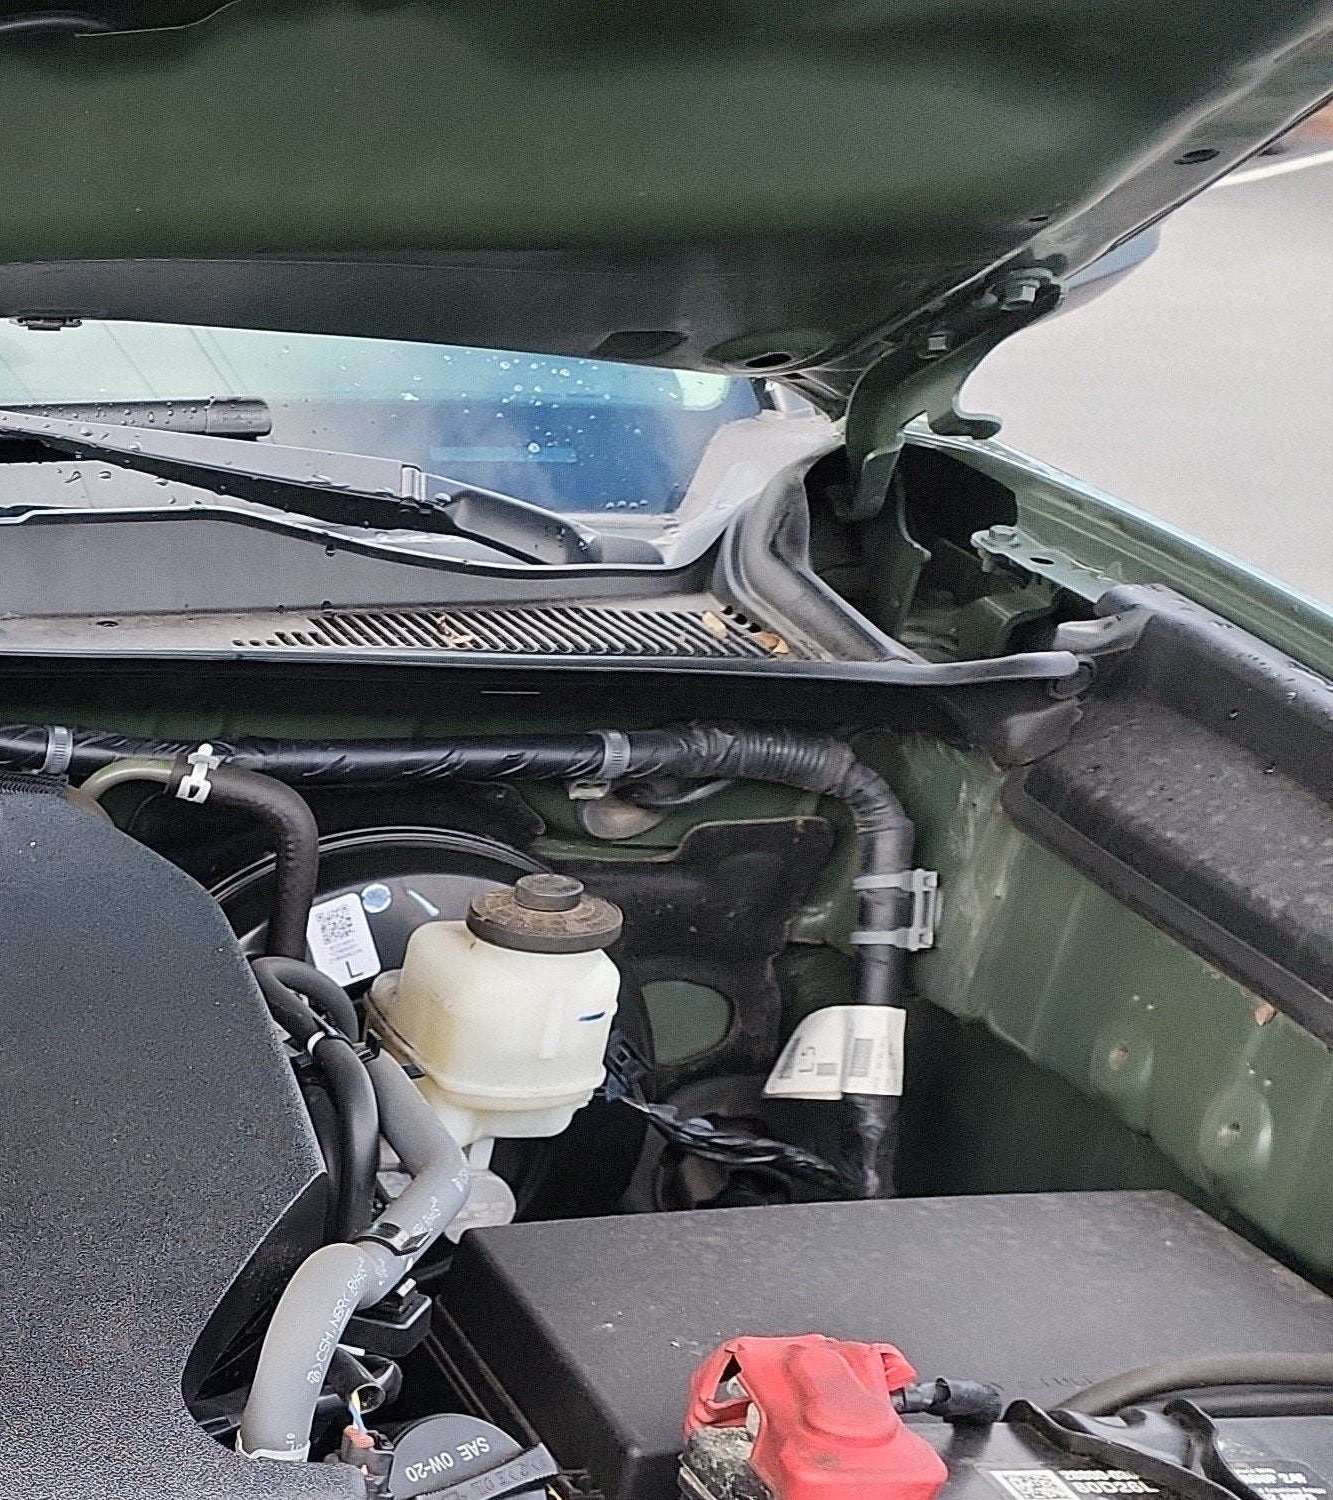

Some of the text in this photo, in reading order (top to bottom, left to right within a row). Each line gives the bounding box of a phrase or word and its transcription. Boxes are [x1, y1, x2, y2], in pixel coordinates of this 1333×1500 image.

[346, 961, 364, 978] L
[405, 1437, 490, 1482] SAE 0W-20
